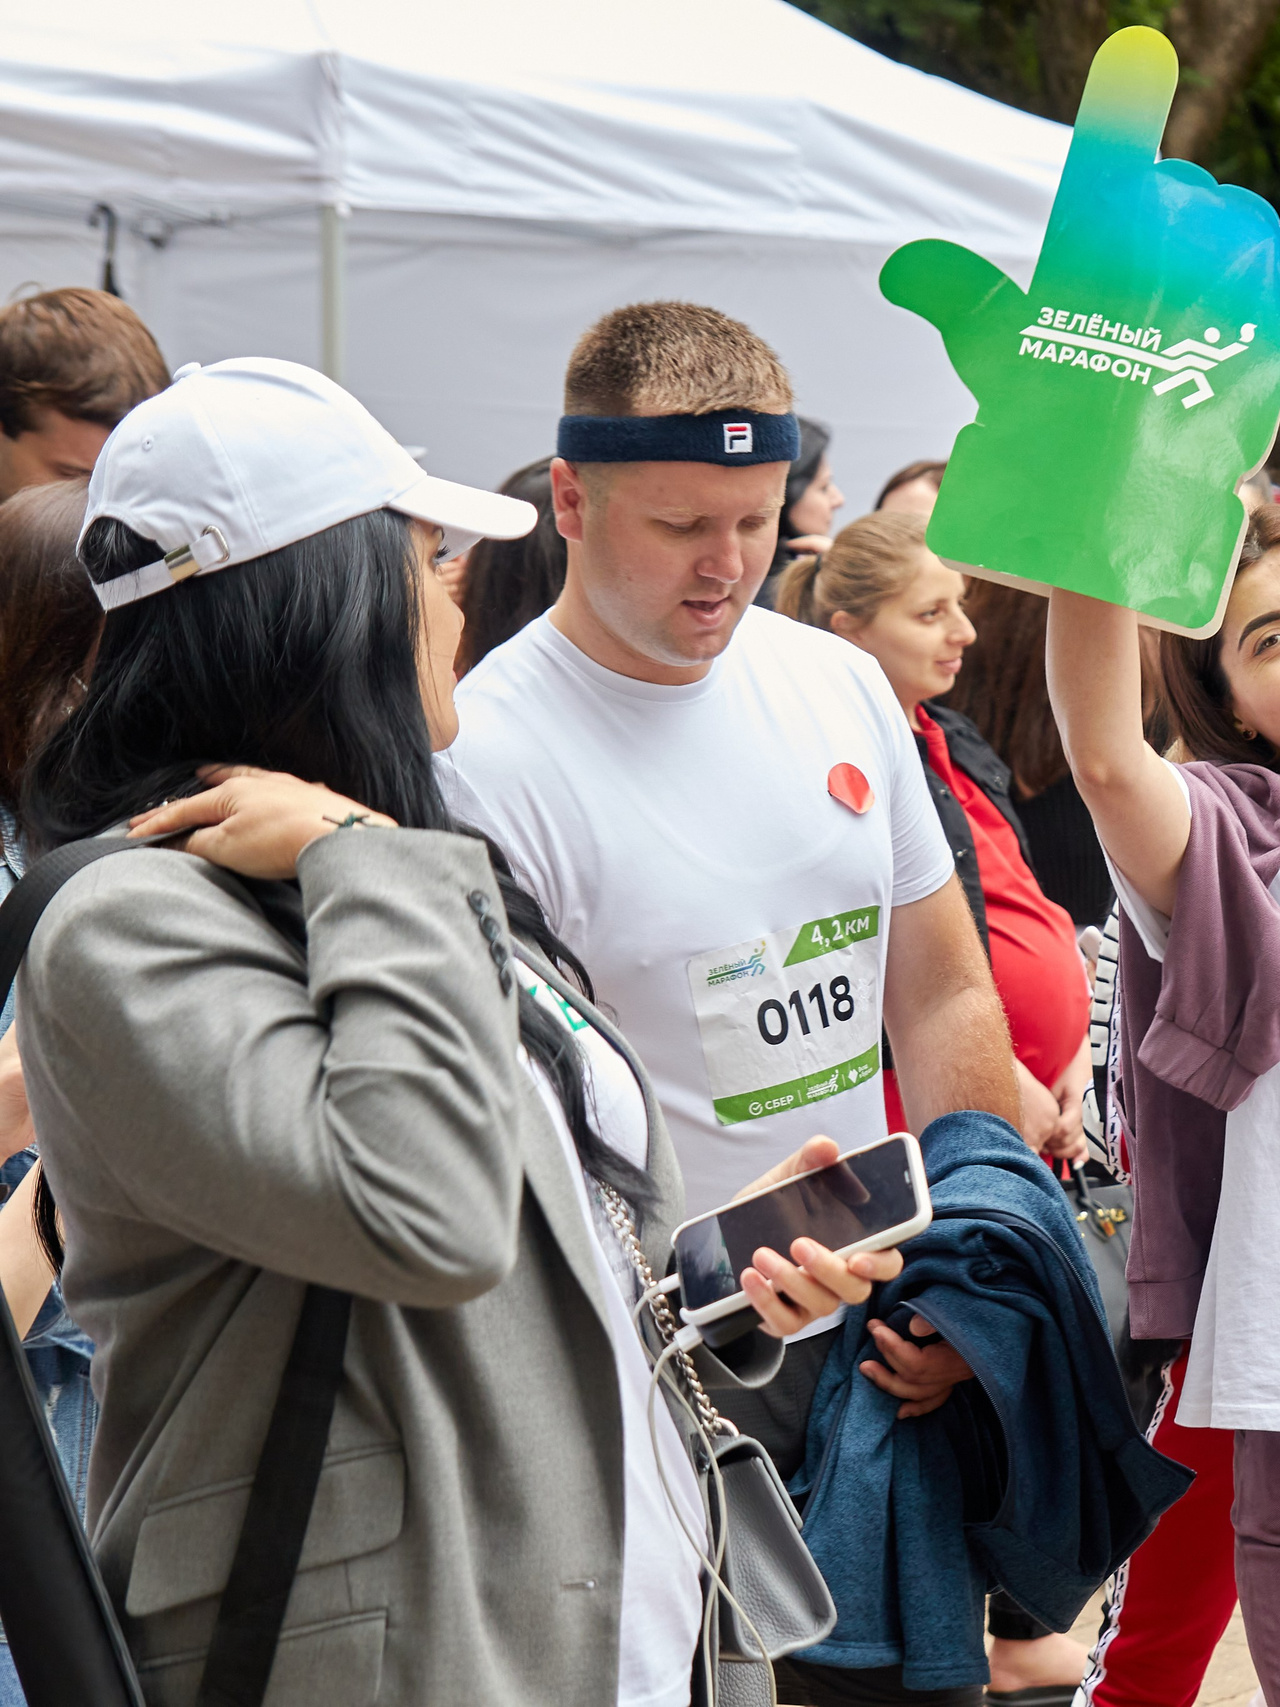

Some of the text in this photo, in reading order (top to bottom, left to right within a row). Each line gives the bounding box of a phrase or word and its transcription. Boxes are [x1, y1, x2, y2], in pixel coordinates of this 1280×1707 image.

[1036, 306, 1163, 352] ЗЕЛЁНЫЙ
[1018, 337, 1153, 385] МАРАФОН
[708, 958, 747, 976] ЗЕЛЁНЫЙ
[708, 969, 750, 987] МАРАФОН
[757, 975, 855, 1046] 0118
[765, 1095, 795, 1110] СБЕР
